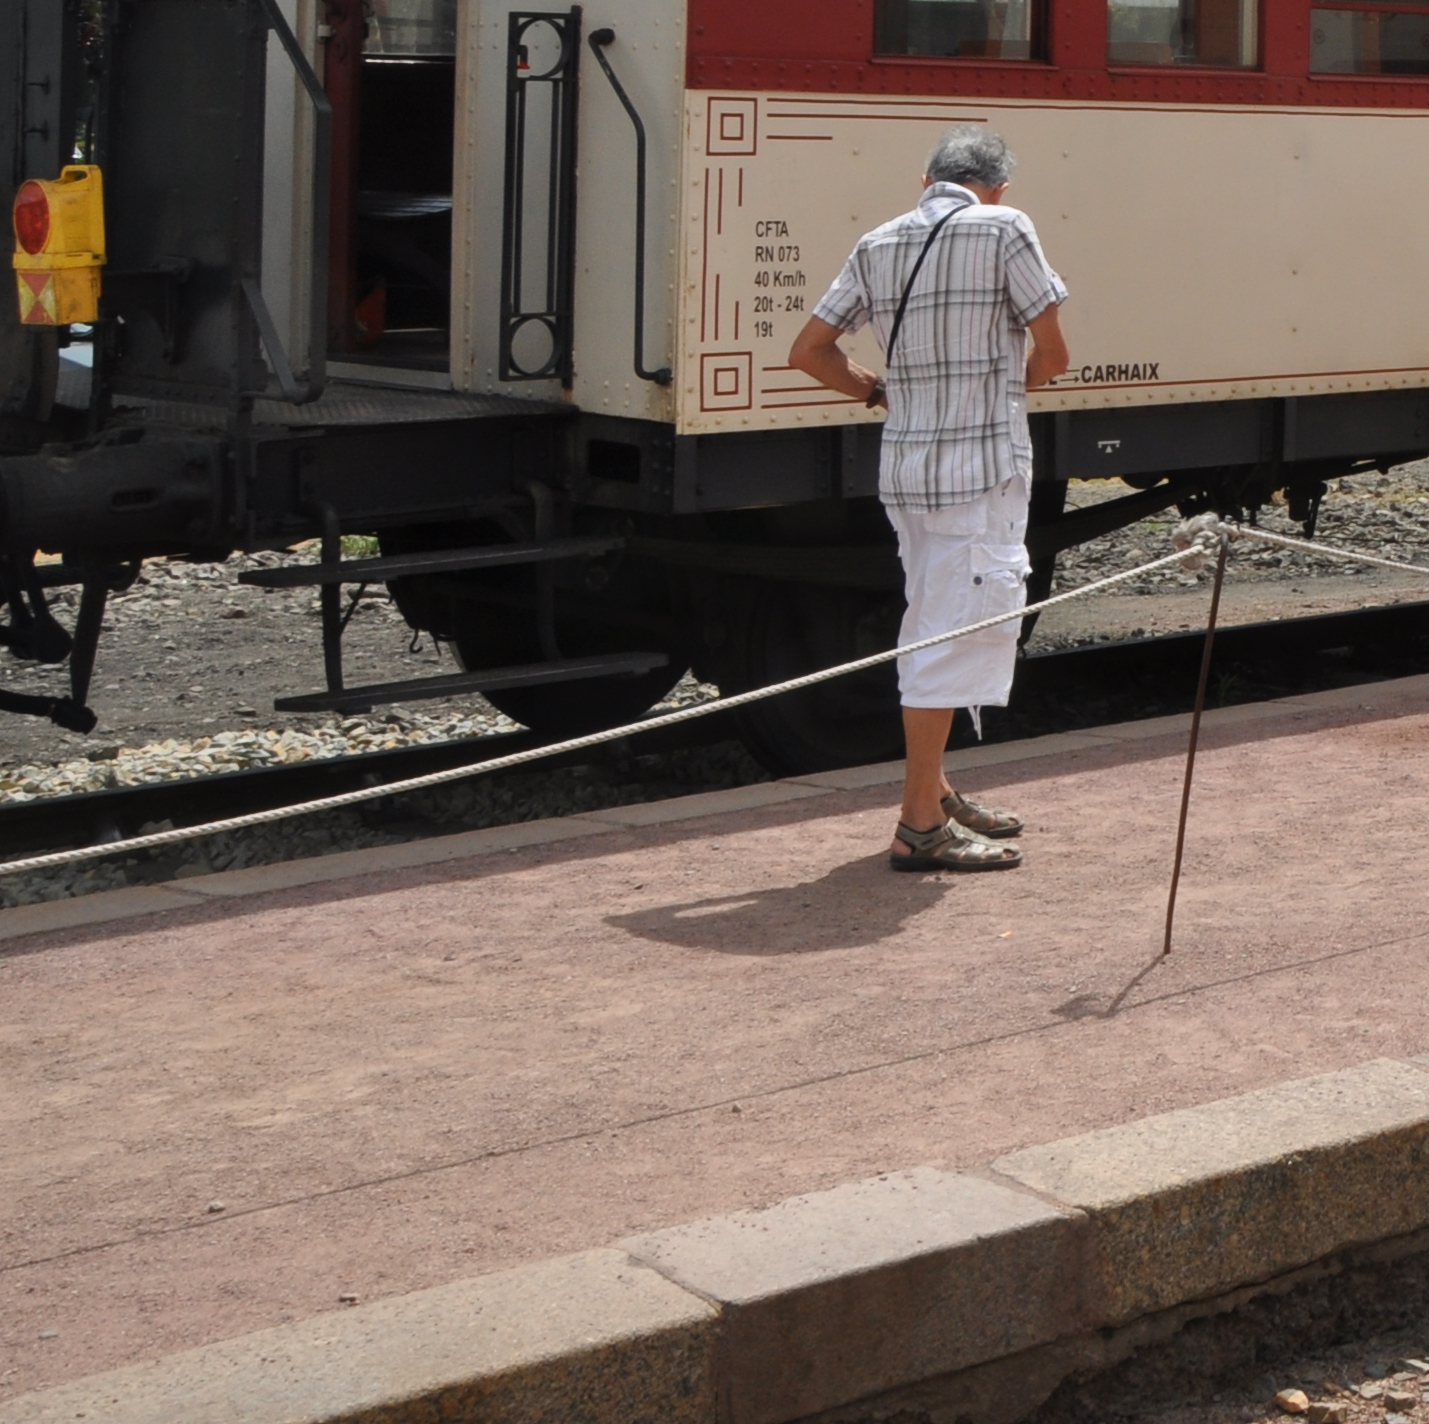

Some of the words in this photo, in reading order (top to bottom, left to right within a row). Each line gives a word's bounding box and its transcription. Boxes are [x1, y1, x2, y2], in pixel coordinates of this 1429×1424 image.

[755, 221, 789, 237] CFTA
[755, 246, 774, 263] RN
[778, 245, 800, 262] 073
[754, 271, 769, 287] 40
[773, 270, 806, 287] Km/h
[754, 296, 774, 312] 20t
[785, 295, 805, 311] 24t
[754, 321, 773, 337] 19t
[1080, 362, 1160, 384] CARHAIX
